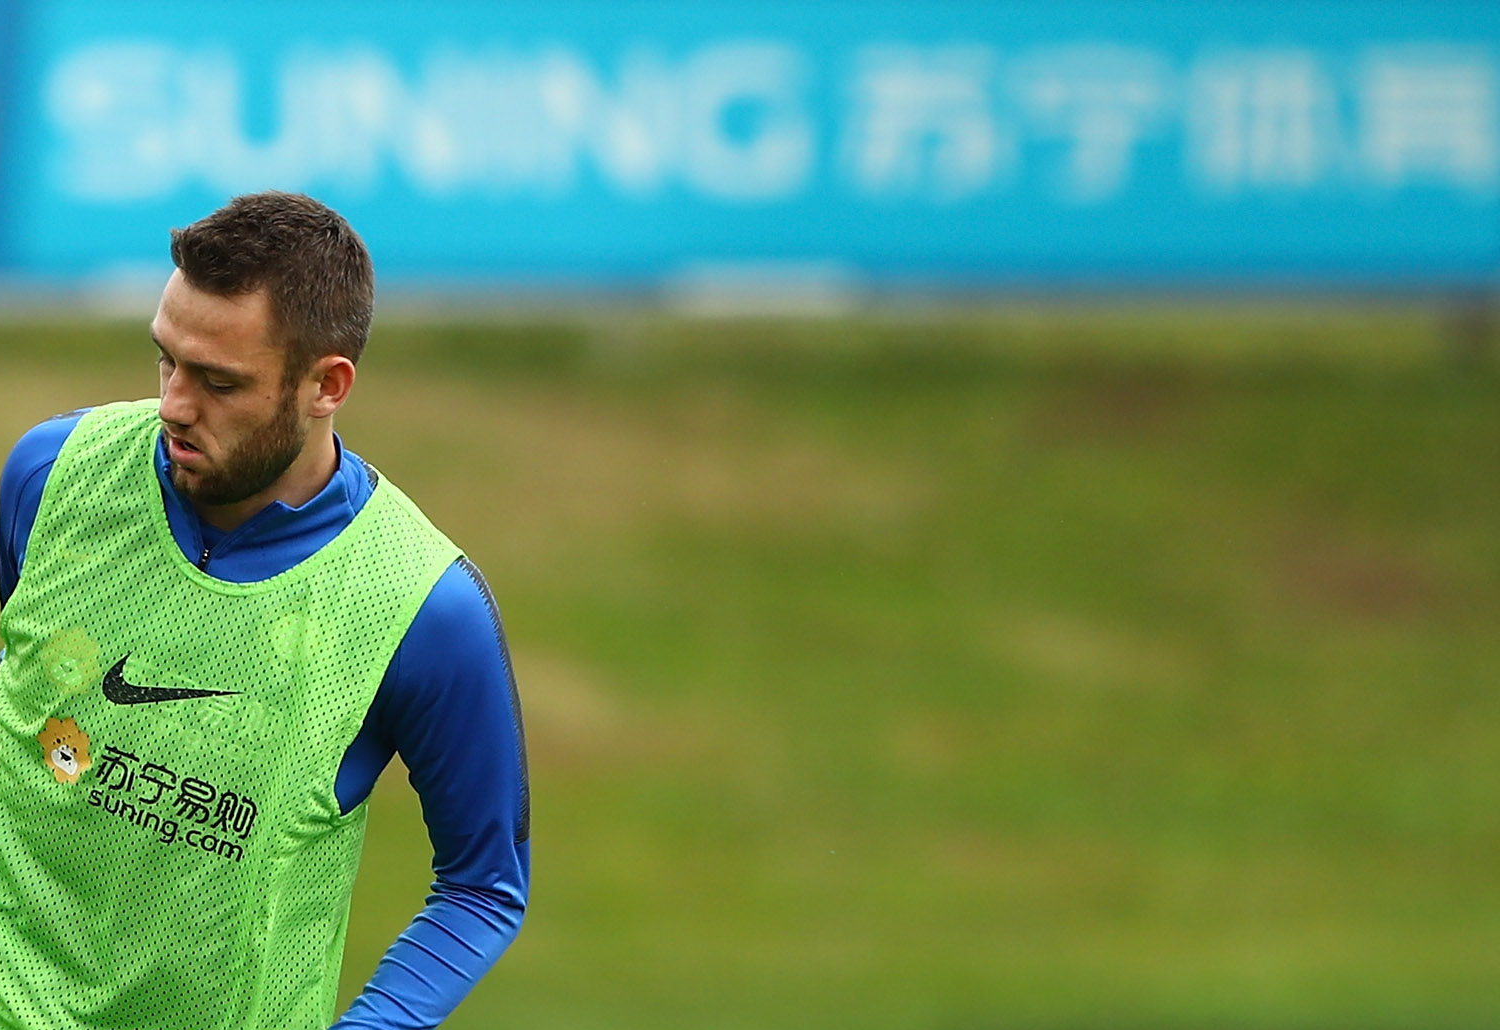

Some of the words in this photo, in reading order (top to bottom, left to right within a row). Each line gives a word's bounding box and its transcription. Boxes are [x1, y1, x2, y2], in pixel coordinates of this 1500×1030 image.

[46, 40, 812, 200] SUNING
[87, 788, 244, 863] suning.com
[95, 744, 257, 840] 苏宁易购
